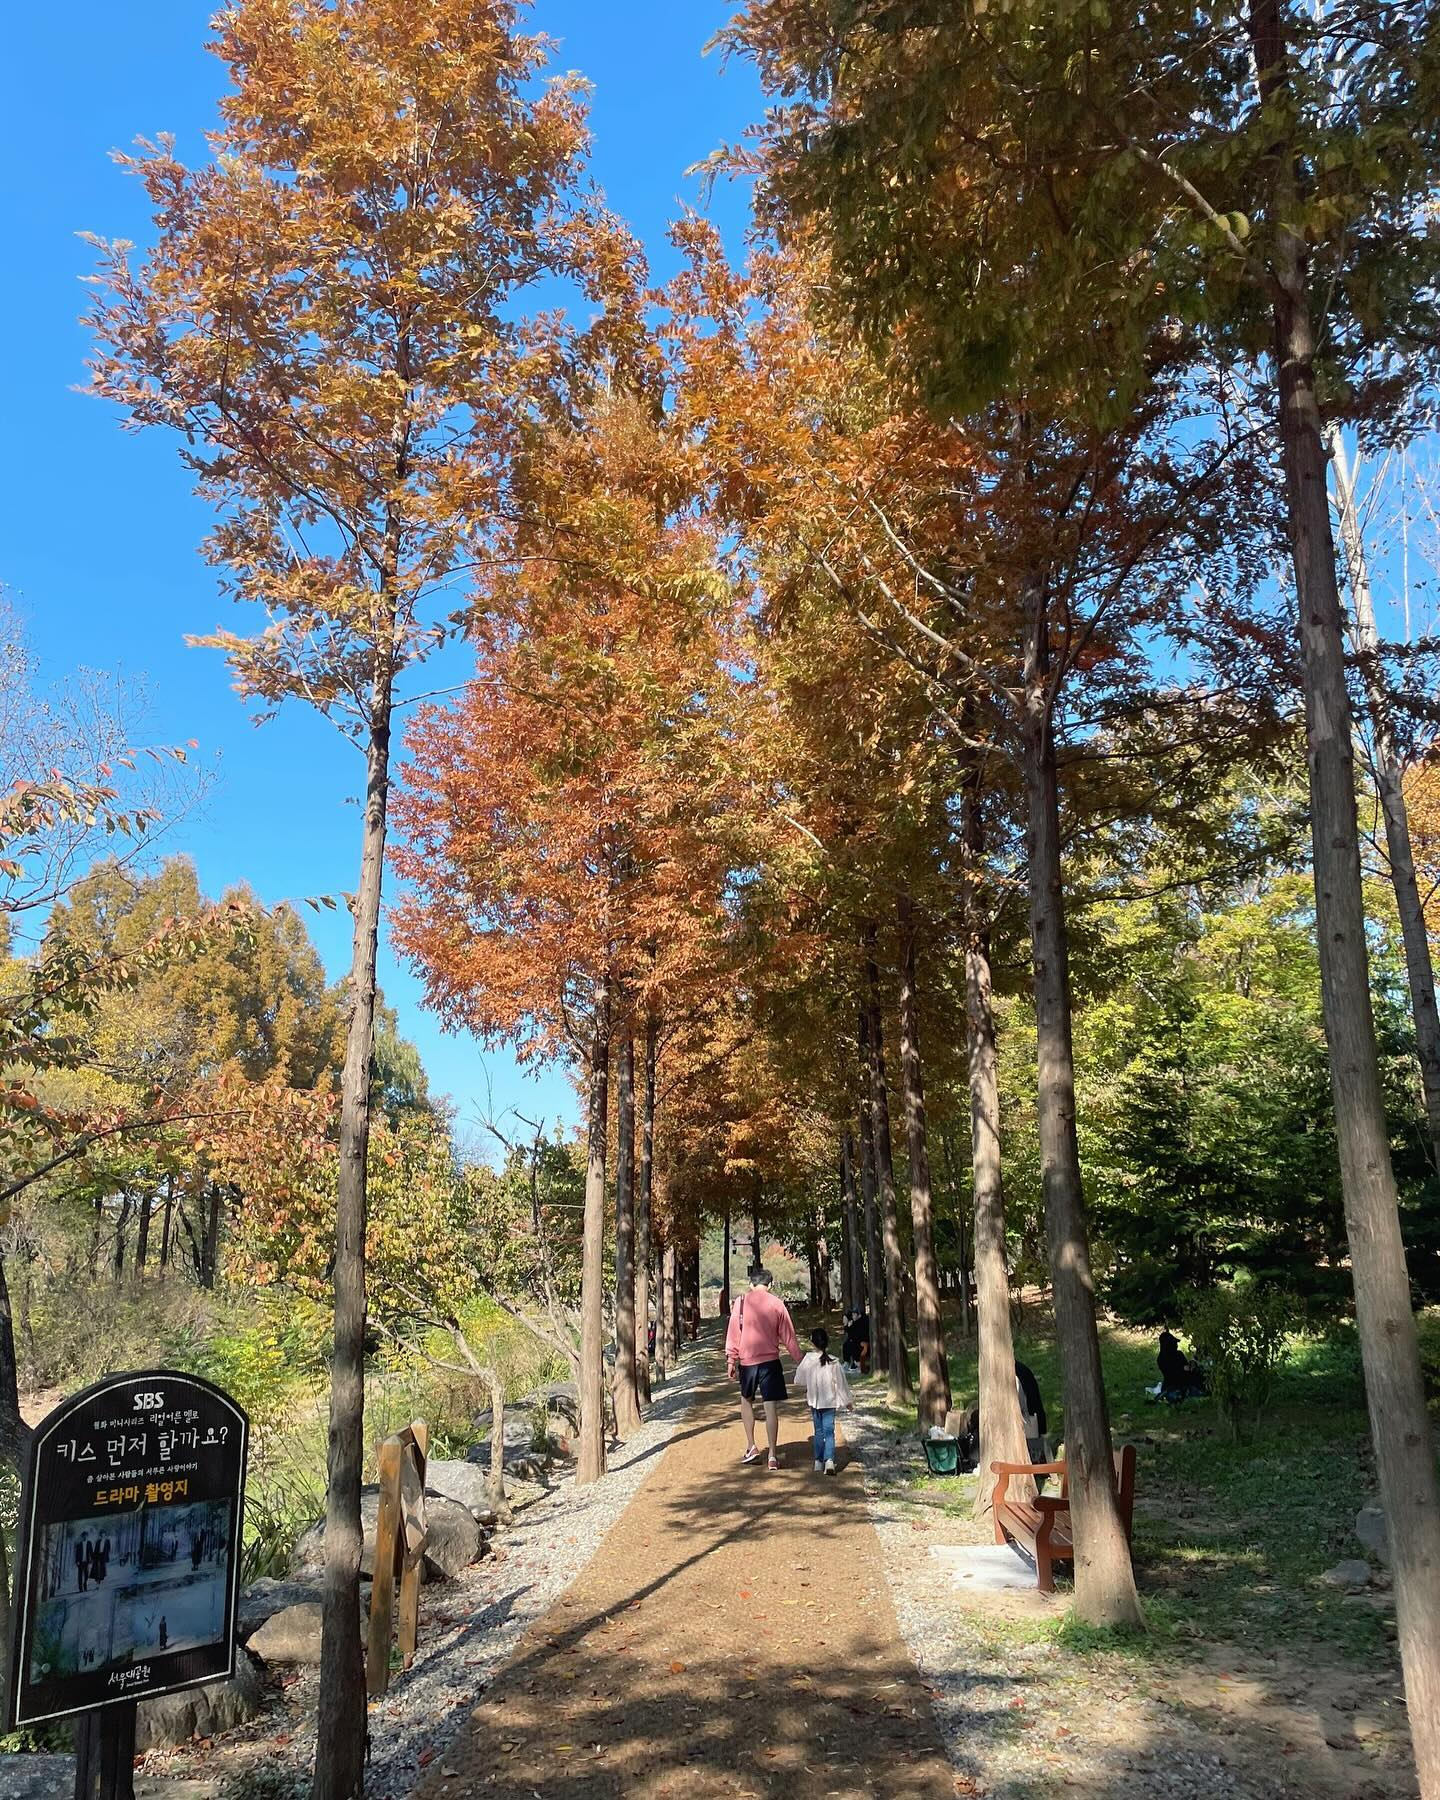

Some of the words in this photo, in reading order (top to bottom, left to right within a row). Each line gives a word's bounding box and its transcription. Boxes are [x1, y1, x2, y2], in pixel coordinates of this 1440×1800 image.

[132, 1391, 165, 1411] SBS
[110, 1417, 145, 1428] 미니시리즈
[184, 1409, 200, 1424] 멜로
[57, 1439, 97, 1462] 키스
[107, 1433, 147, 1466] 먼저
[157, 1426, 229, 1461] 할까요?
[96, 1472, 116, 1483] 살아본
[117, 1468, 144, 1479] 사람들의
[166, 1462, 198, 1473] 사랑이야기
[93, 1485, 140, 1506] 드라마
[144, 1478, 189, 1503] 촬영지
[108, 1665, 151, 1690] 서울대공원
